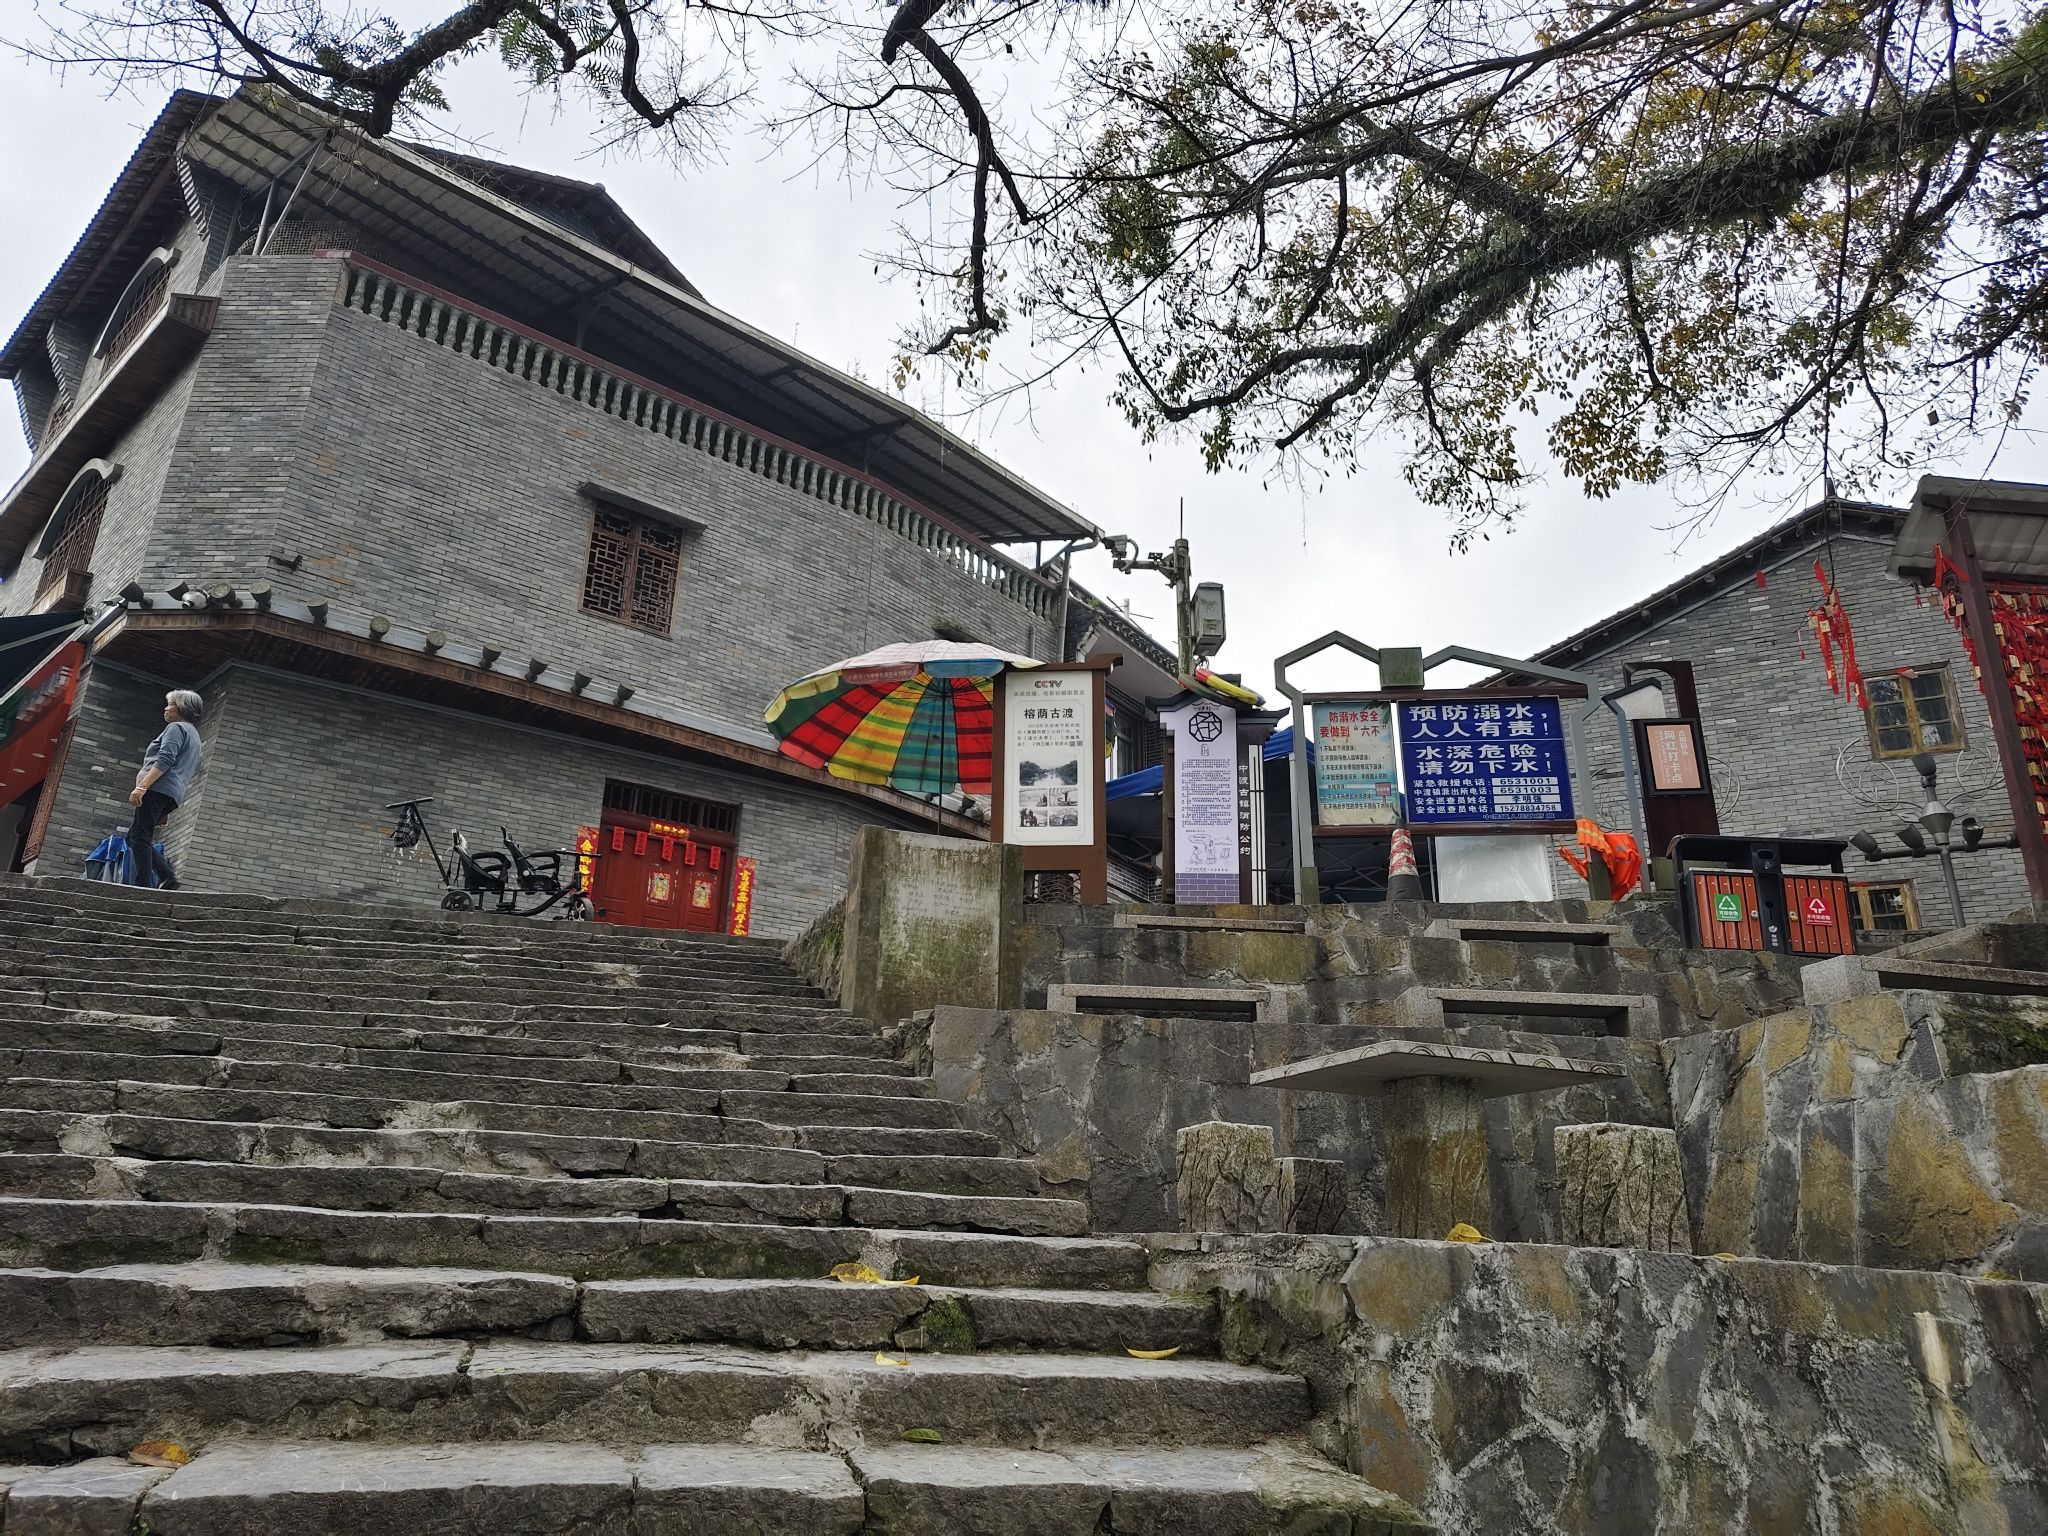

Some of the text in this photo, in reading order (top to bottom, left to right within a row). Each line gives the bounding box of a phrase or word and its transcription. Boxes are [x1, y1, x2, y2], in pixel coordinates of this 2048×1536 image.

[1035, 680, 1063, 688] CCTV
[1024, 707, 1074, 719] 榕荫古渡
[1329, 710, 1380, 723] 防溺水安全
[1664, 730, 1683, 784] 网红打卡点
[1500, 804, 1556, 812] 15278834758
